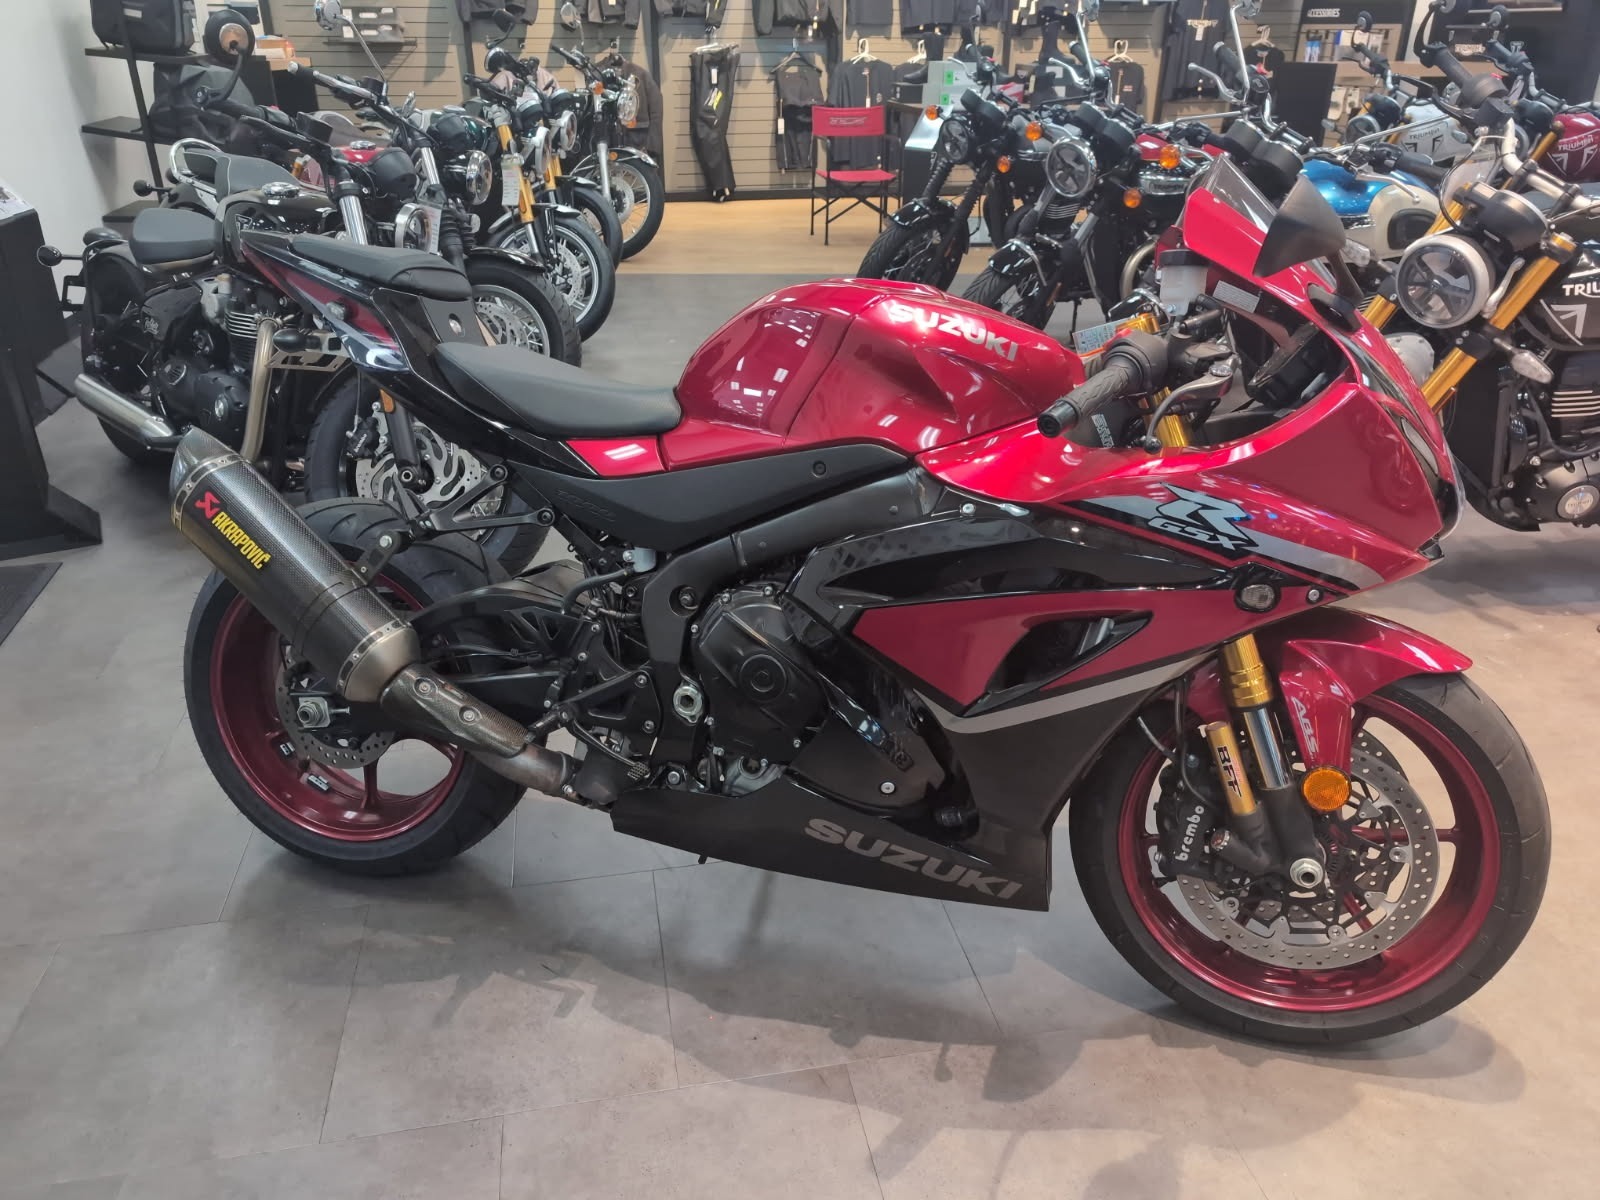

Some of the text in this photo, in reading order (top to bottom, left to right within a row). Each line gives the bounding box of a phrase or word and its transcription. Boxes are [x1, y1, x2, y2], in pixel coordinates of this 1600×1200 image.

[1408, 127, 1441, 141] TRIUMPH
[1557, 134, 1595, 153] TRIUMPH
[887, 302, 1019, 362] SUZUKI
[1290, 696, 1320, 758] ABS
[1216, 744, 1243, 798] BFF
[804, 818, 1024, 899] SUZUKI
[1174, 804, 1206, 863] brembo
